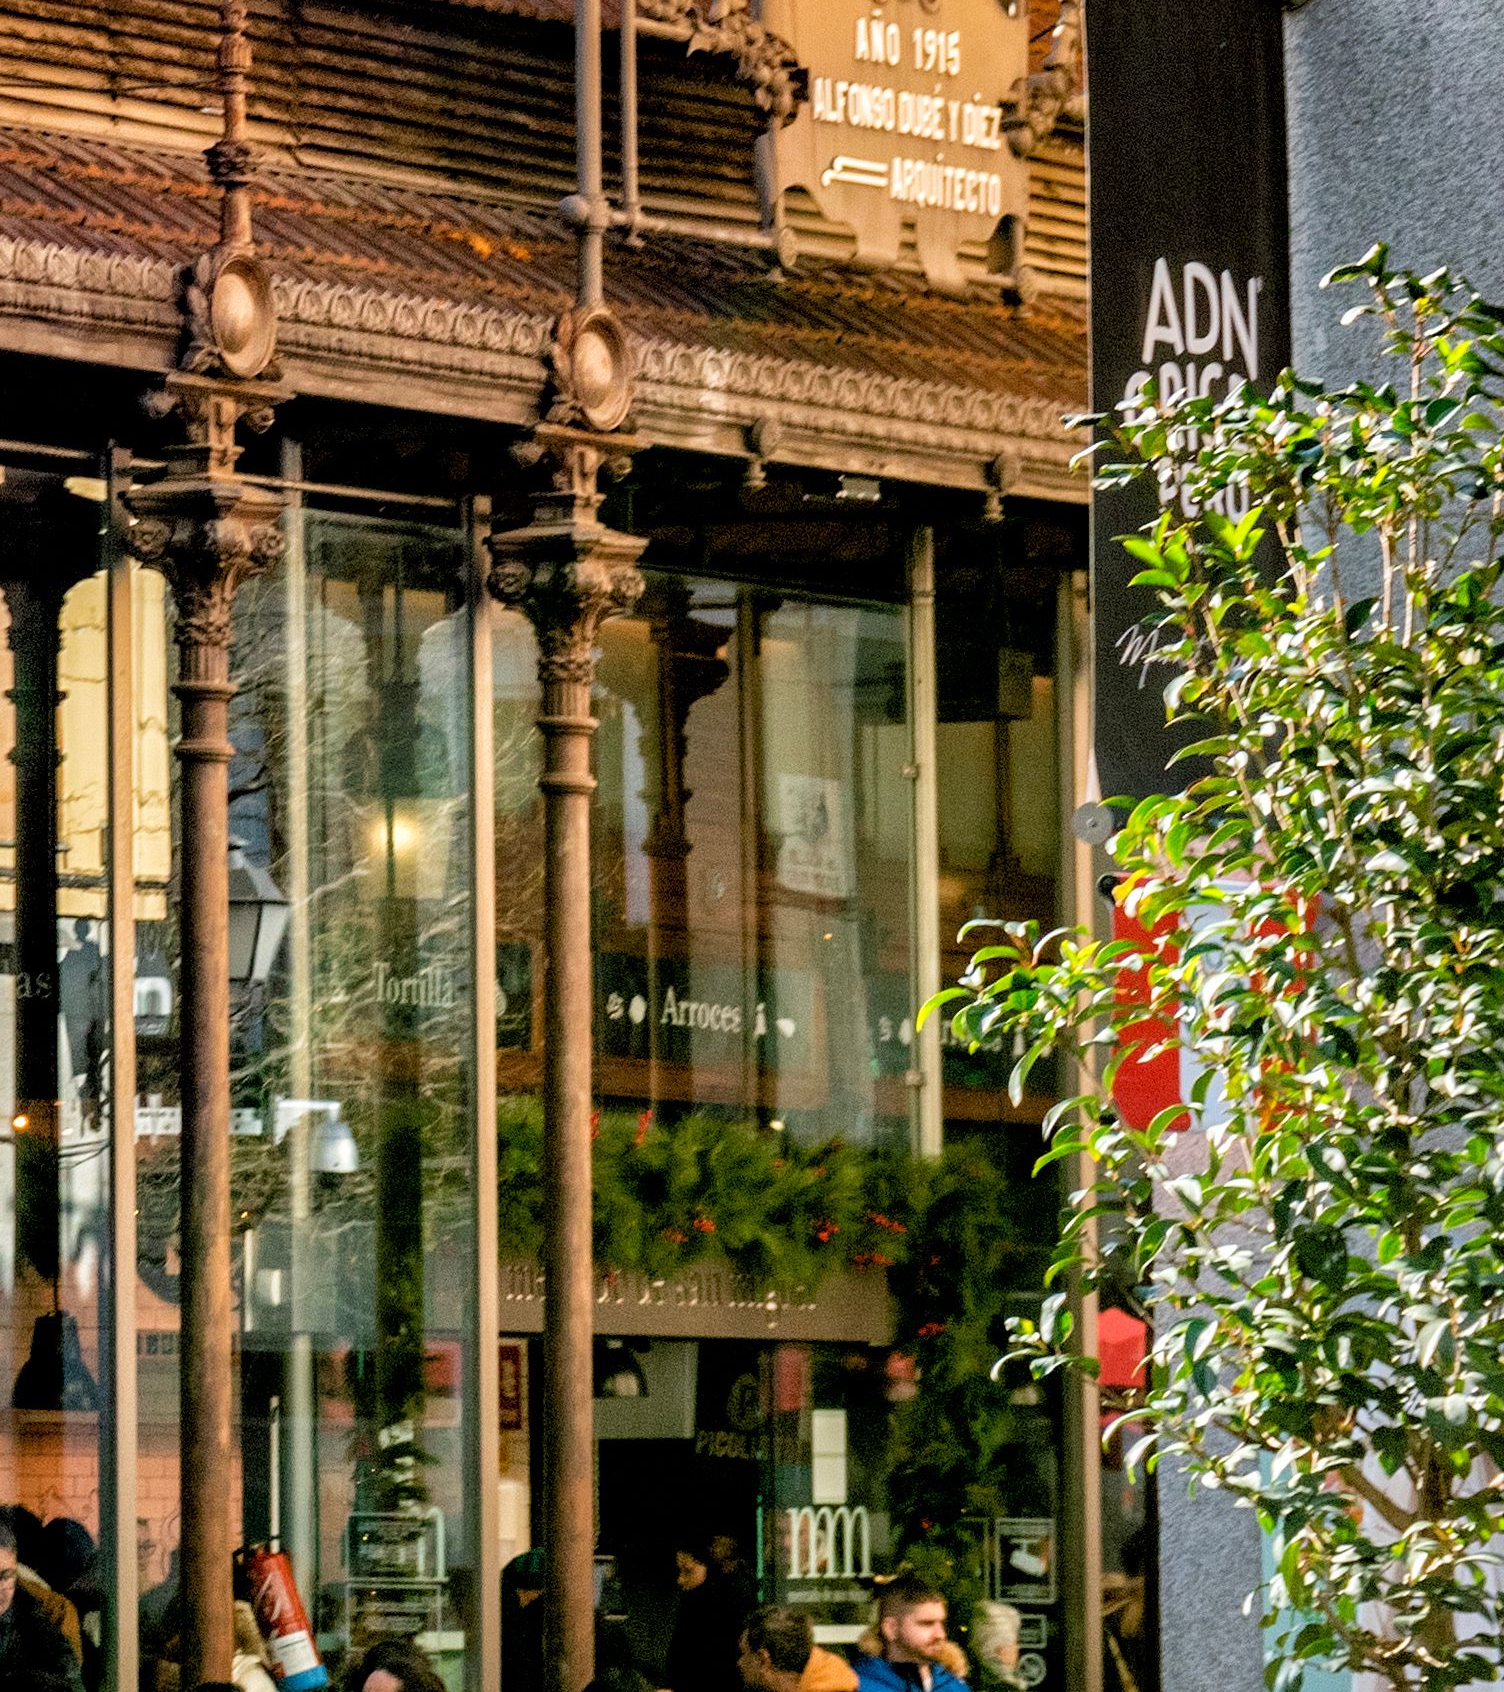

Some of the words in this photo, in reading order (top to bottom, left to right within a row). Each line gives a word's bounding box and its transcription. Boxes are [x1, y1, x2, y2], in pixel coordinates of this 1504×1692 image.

[854, 9, 901, 66] AÑO
[913, 27, 961, 77] 1915
[812, 77, 896, 132] ALFONSO
[948, 99, 961, 143] Y
[1141, 256, 1260, 382] ADN
[659, 985, 742, 1034] Arroces
